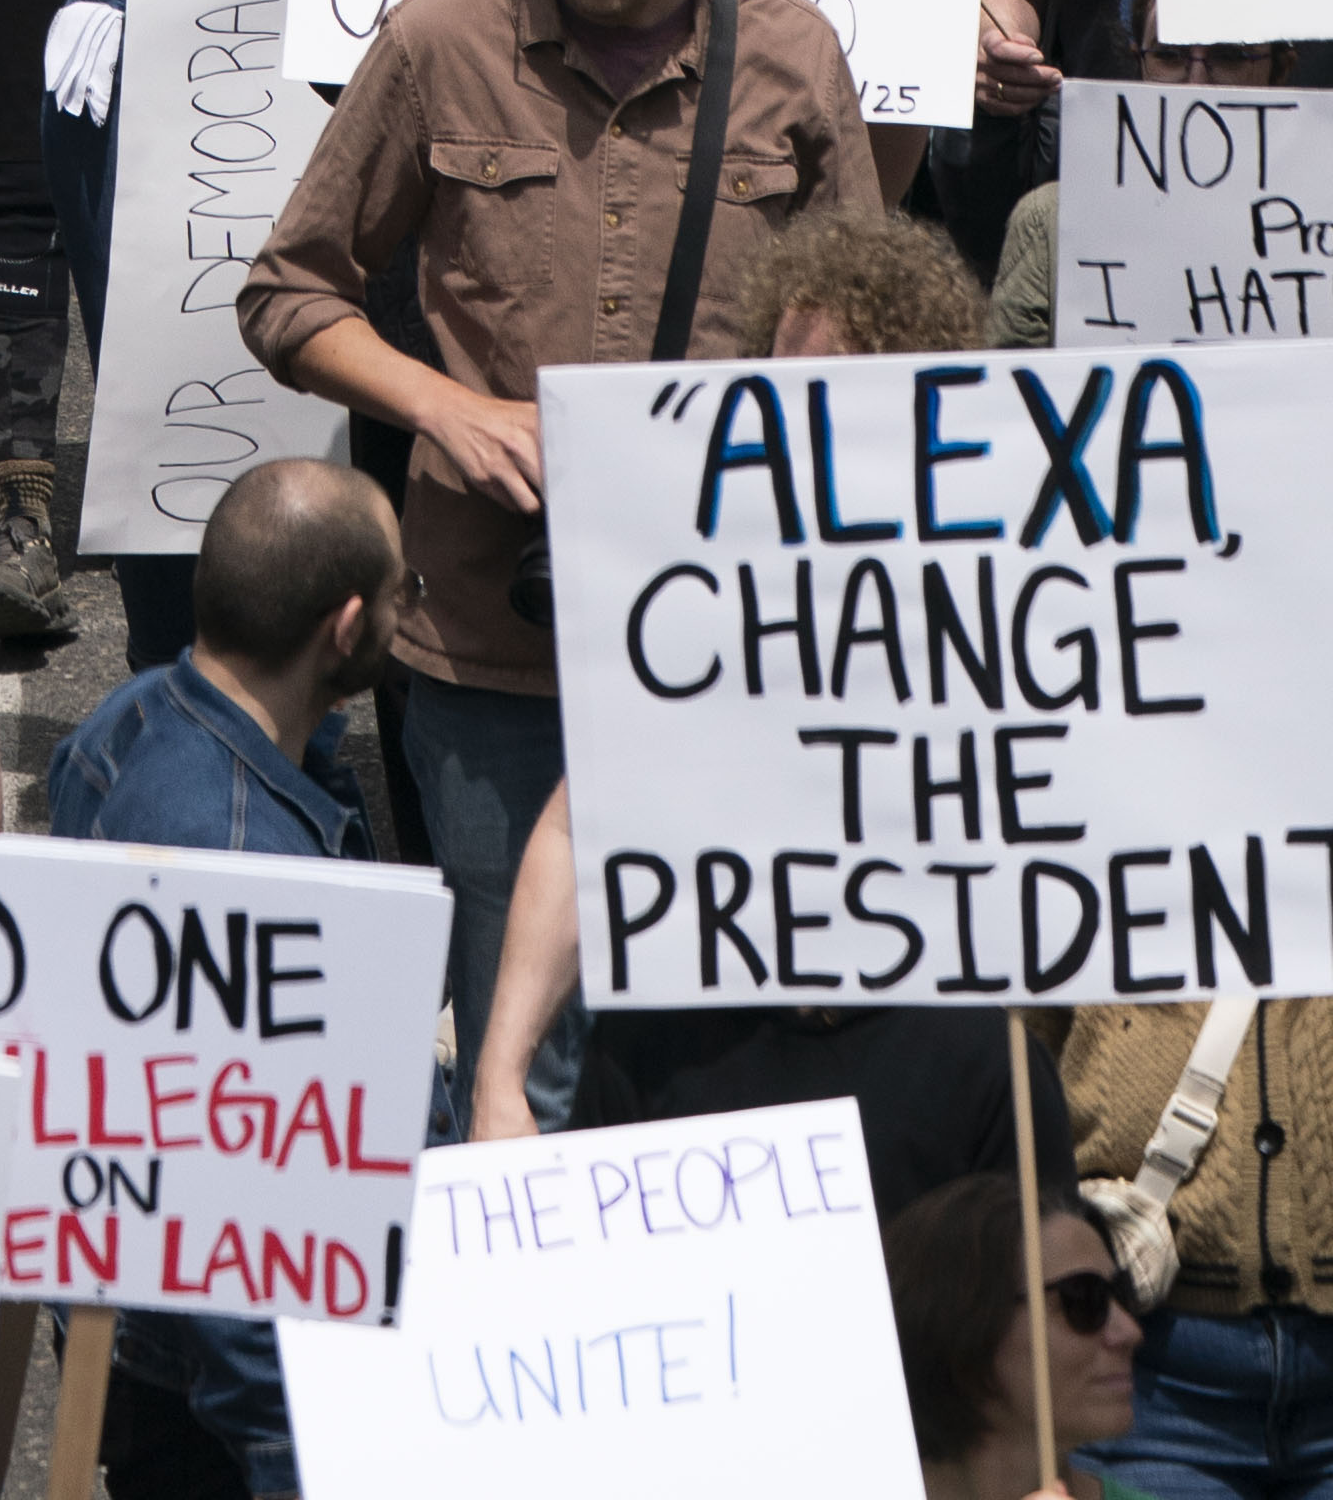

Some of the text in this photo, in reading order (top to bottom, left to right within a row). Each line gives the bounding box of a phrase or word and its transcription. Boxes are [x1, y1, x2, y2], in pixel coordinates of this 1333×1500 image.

[1114, 91, 1299, 195] NOT
[626, 555, 1206, 716] CHANGE
[797, 724, 1088, 845] THE
[99, 899, 325, 1040] ONE
[63, 1150, 162, 1216] ON
[423, 1132, 862, 1256] THE PEOPLE
